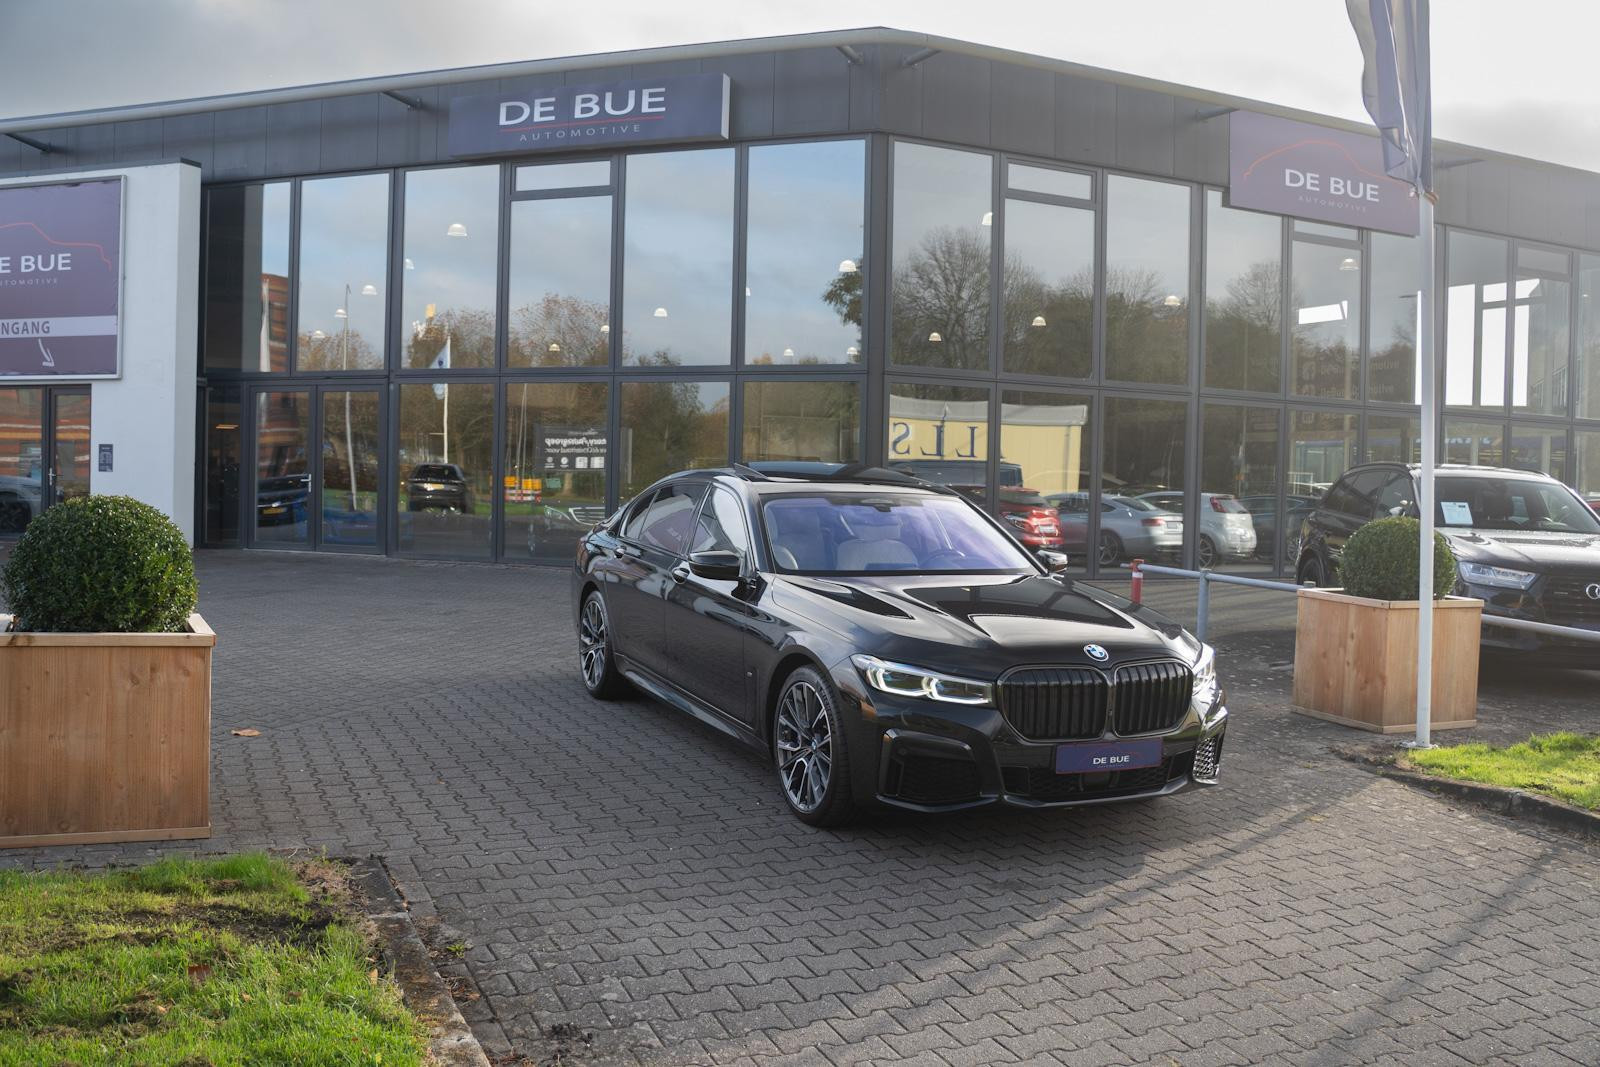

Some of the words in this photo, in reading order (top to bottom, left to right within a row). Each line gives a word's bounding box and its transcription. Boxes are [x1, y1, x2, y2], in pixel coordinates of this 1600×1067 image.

[498, 97, 556, 126] DE
[574, 87, 666, 119] BUE
[519, 124, 641, 142] AUTOMOTIVE
[1284, 167, 1320, 191] DE
[1329, 176, 1380, 202] BUE
[1298, 195, 1367, 212] AUTOMOTIVE
[0, 256, 12, 274] E
[20, 252, 72, 273] BUE
[0, 320, 51, 336] NGANG
[1093, 757, 1107, 765] DE
[1109, 755, 1130, 764] BUE
